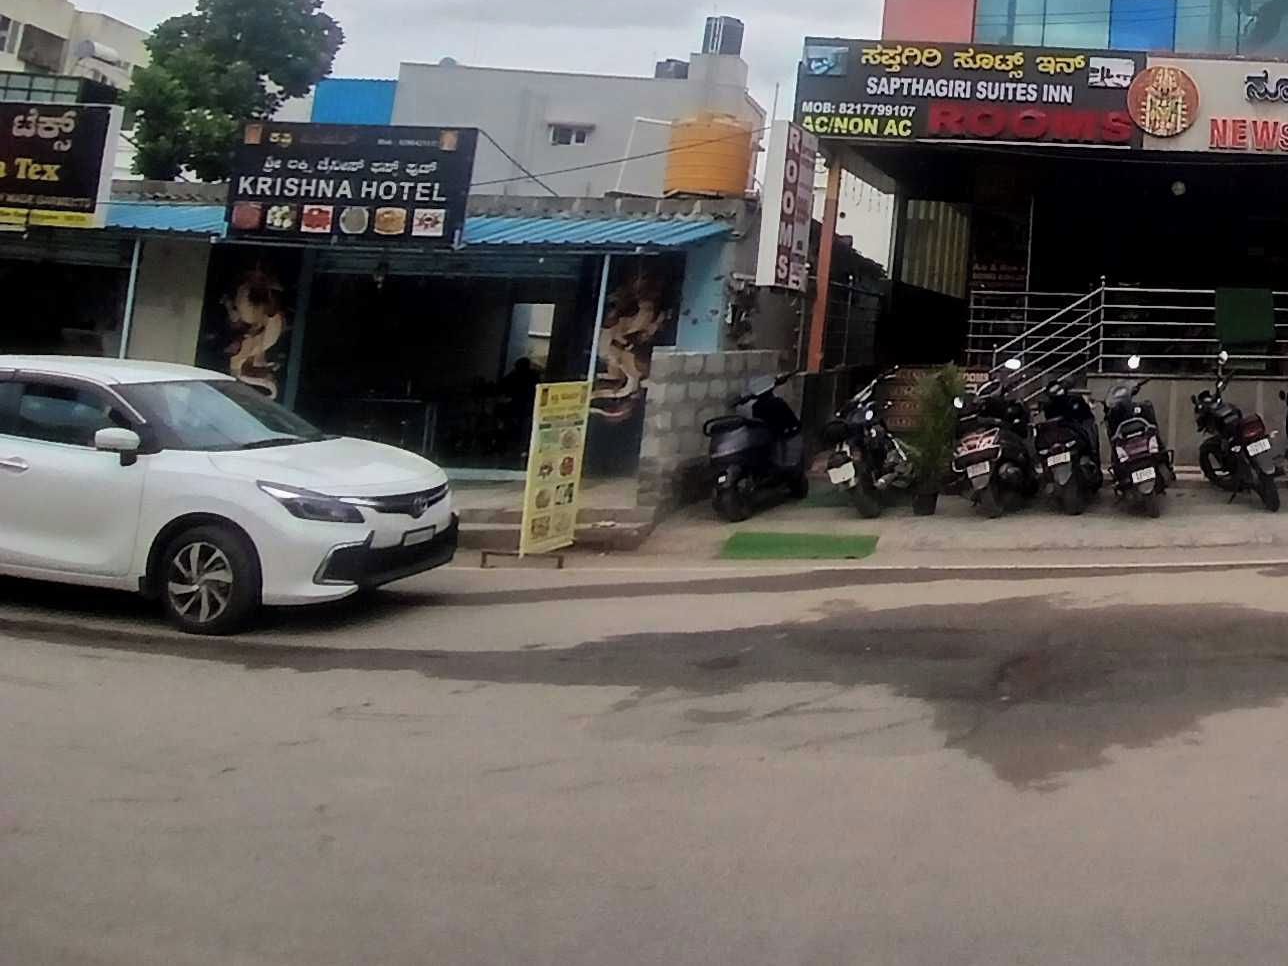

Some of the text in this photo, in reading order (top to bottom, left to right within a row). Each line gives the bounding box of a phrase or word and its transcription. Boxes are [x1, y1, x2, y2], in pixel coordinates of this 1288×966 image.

[860, 44, 943, 73] ಸಪ್ತಗಿರಿ
[1035, 54, 1086, 75] ಇನ್
[866, 76, 1073, 104] SAPTHAGIRI SUITES INN
[801, 101, 916, 118] MOB: 8217799107
[932, 104, 1132, 142] ROOMS
[802, 115, 912, 137] AC/NON AC
[15, 157, 61, 181] Tex
[237, 176, 447, 202] KRISHNA HOTEL
[777, 128, 802, 280] ROOMS
